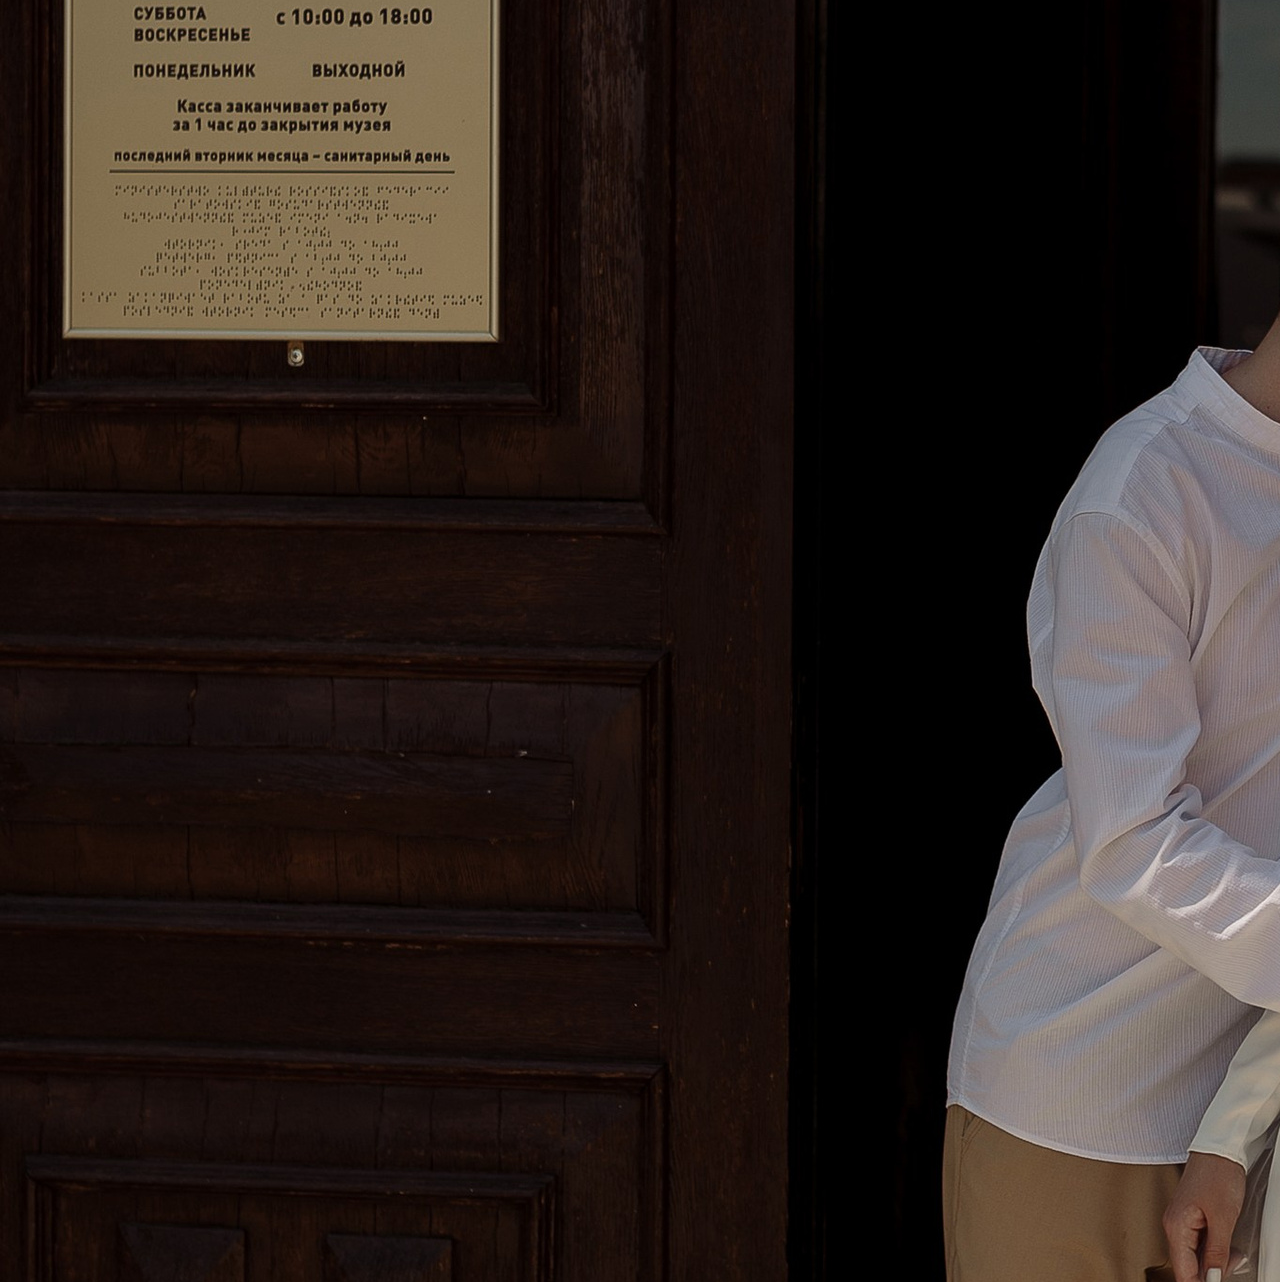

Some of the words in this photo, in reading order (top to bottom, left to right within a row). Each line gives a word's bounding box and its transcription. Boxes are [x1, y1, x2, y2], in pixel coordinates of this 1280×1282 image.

[133, 5, 207, 21] СУББОТА
[276, 11, 286, 26] с
[291, 7, 345, 26] 10:00
[349, 11, 374, 28] до
[379, 7, 433, 26] 18:00
[133, 27, 251, 43] ВОСКРЕСЕНЬЕ
[133, 63, 256, 81] ПОНЕДЕЛЬНИК
[312, 60, 406, 81] ВЫХОДНОЙ
[177, 98, 222, 114] Касса
[225, 101, 330, 114] заканчивает
[332, 98, 388, 117] работу
[172, 119, 190, 132] за
[194, 116, 202, 132] 1
[207, 119, 234, 132] час
[237, 119, 257, 134] до
[260, 119, 339, 135] закрытия
[343, 119, 391, 135] музея
[114, 148, 191, 164] последний
[194, 151, 254, 165] вторник
[256, 151, 309, 164] месяца
[323, 148, 412, 165] санитарный
[414, 151, 451, 165] день
